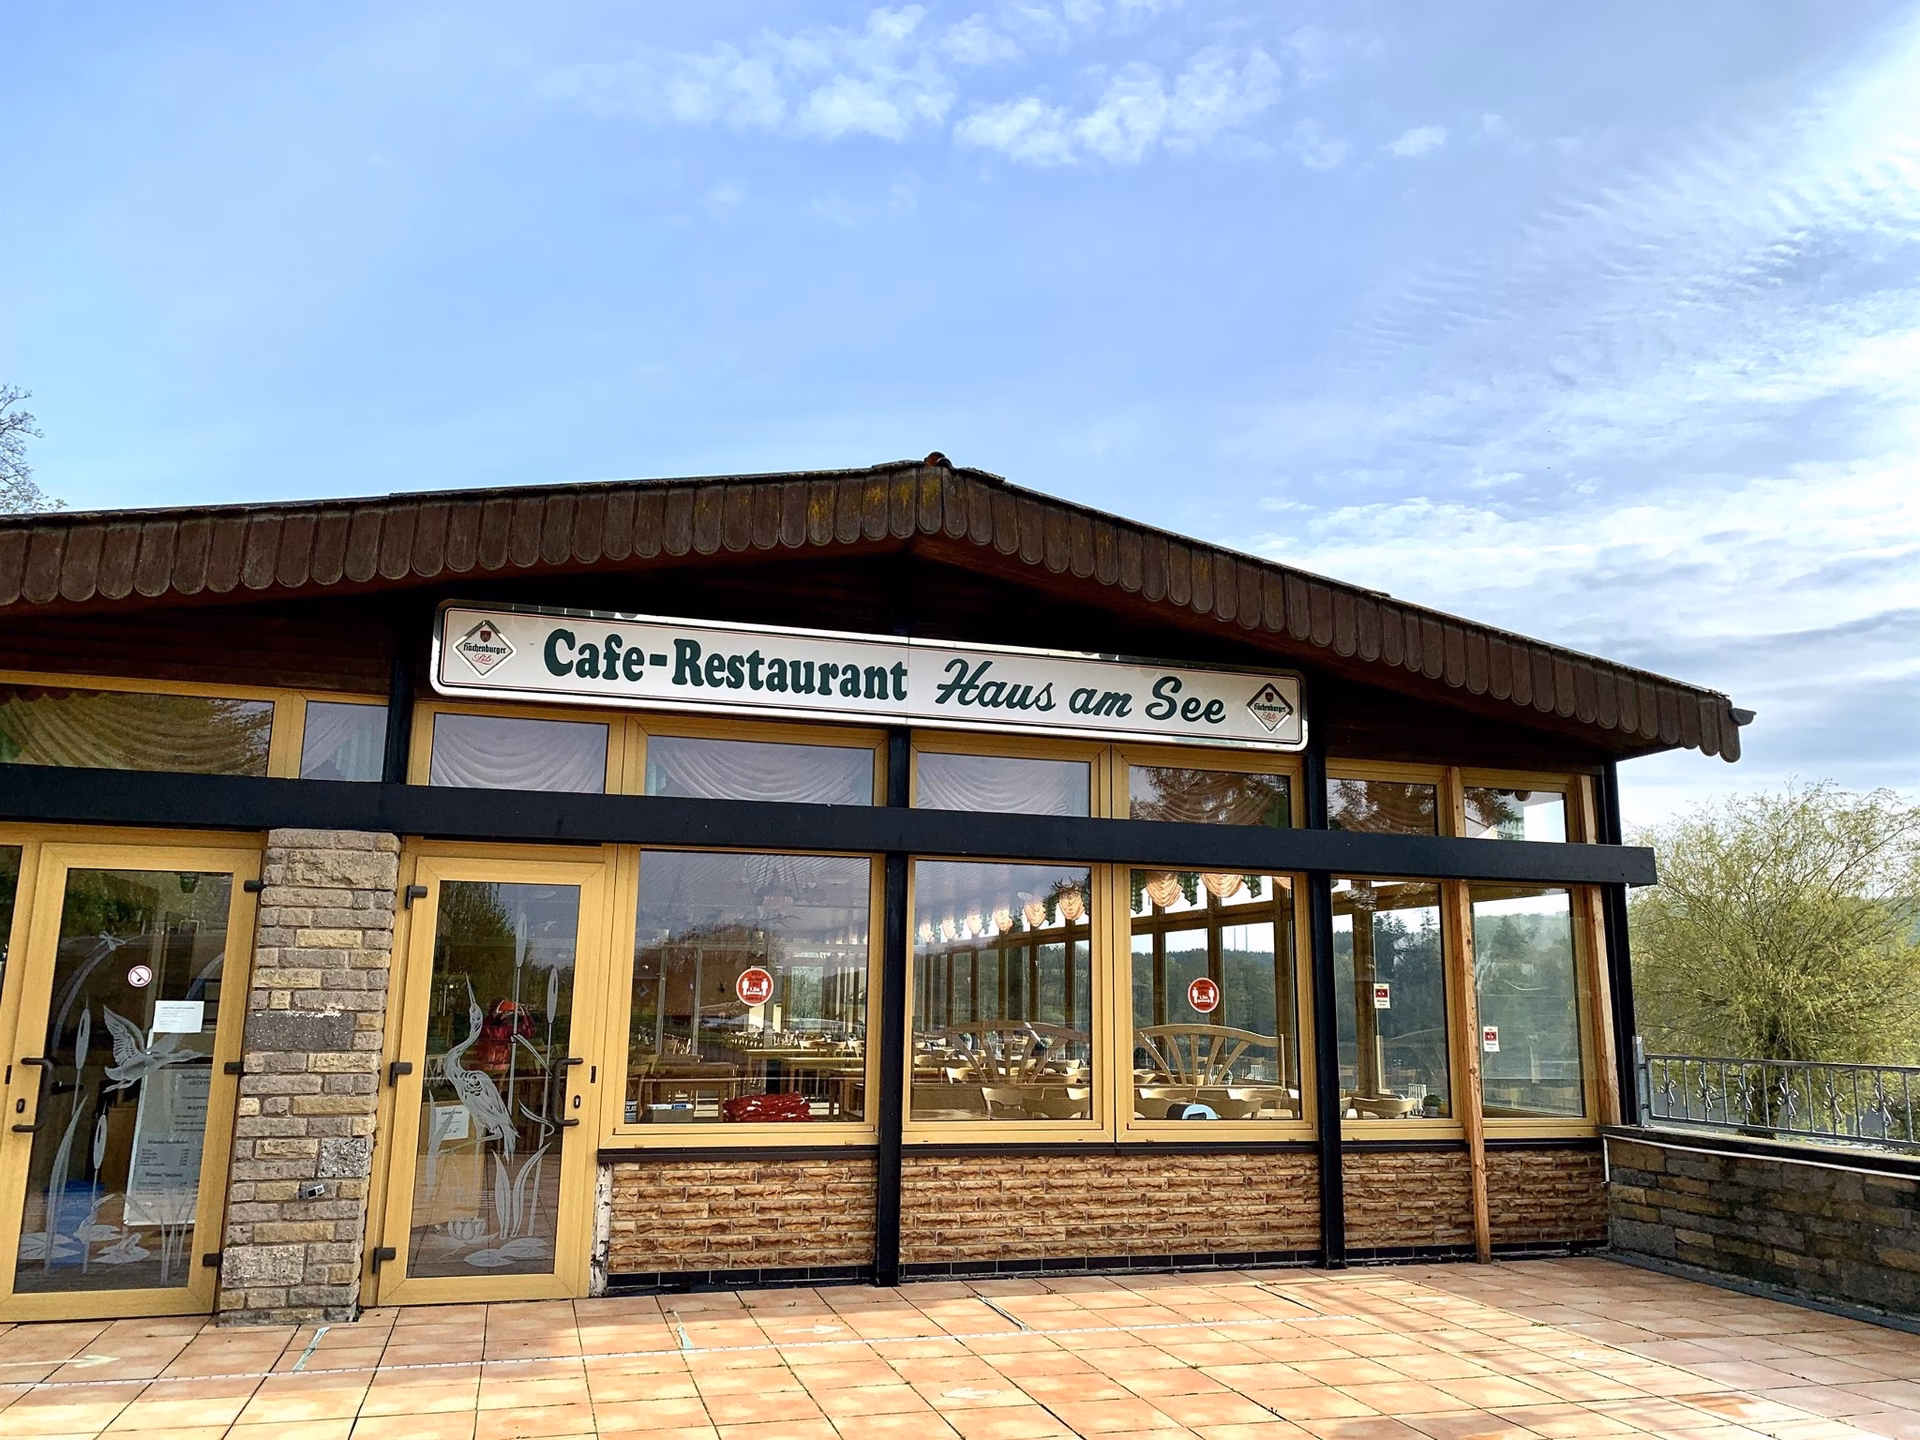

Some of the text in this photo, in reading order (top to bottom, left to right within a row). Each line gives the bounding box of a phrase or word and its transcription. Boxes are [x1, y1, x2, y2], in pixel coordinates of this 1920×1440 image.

[544, 628, 1226, 724] Cafe-Restaurant Haus am See
